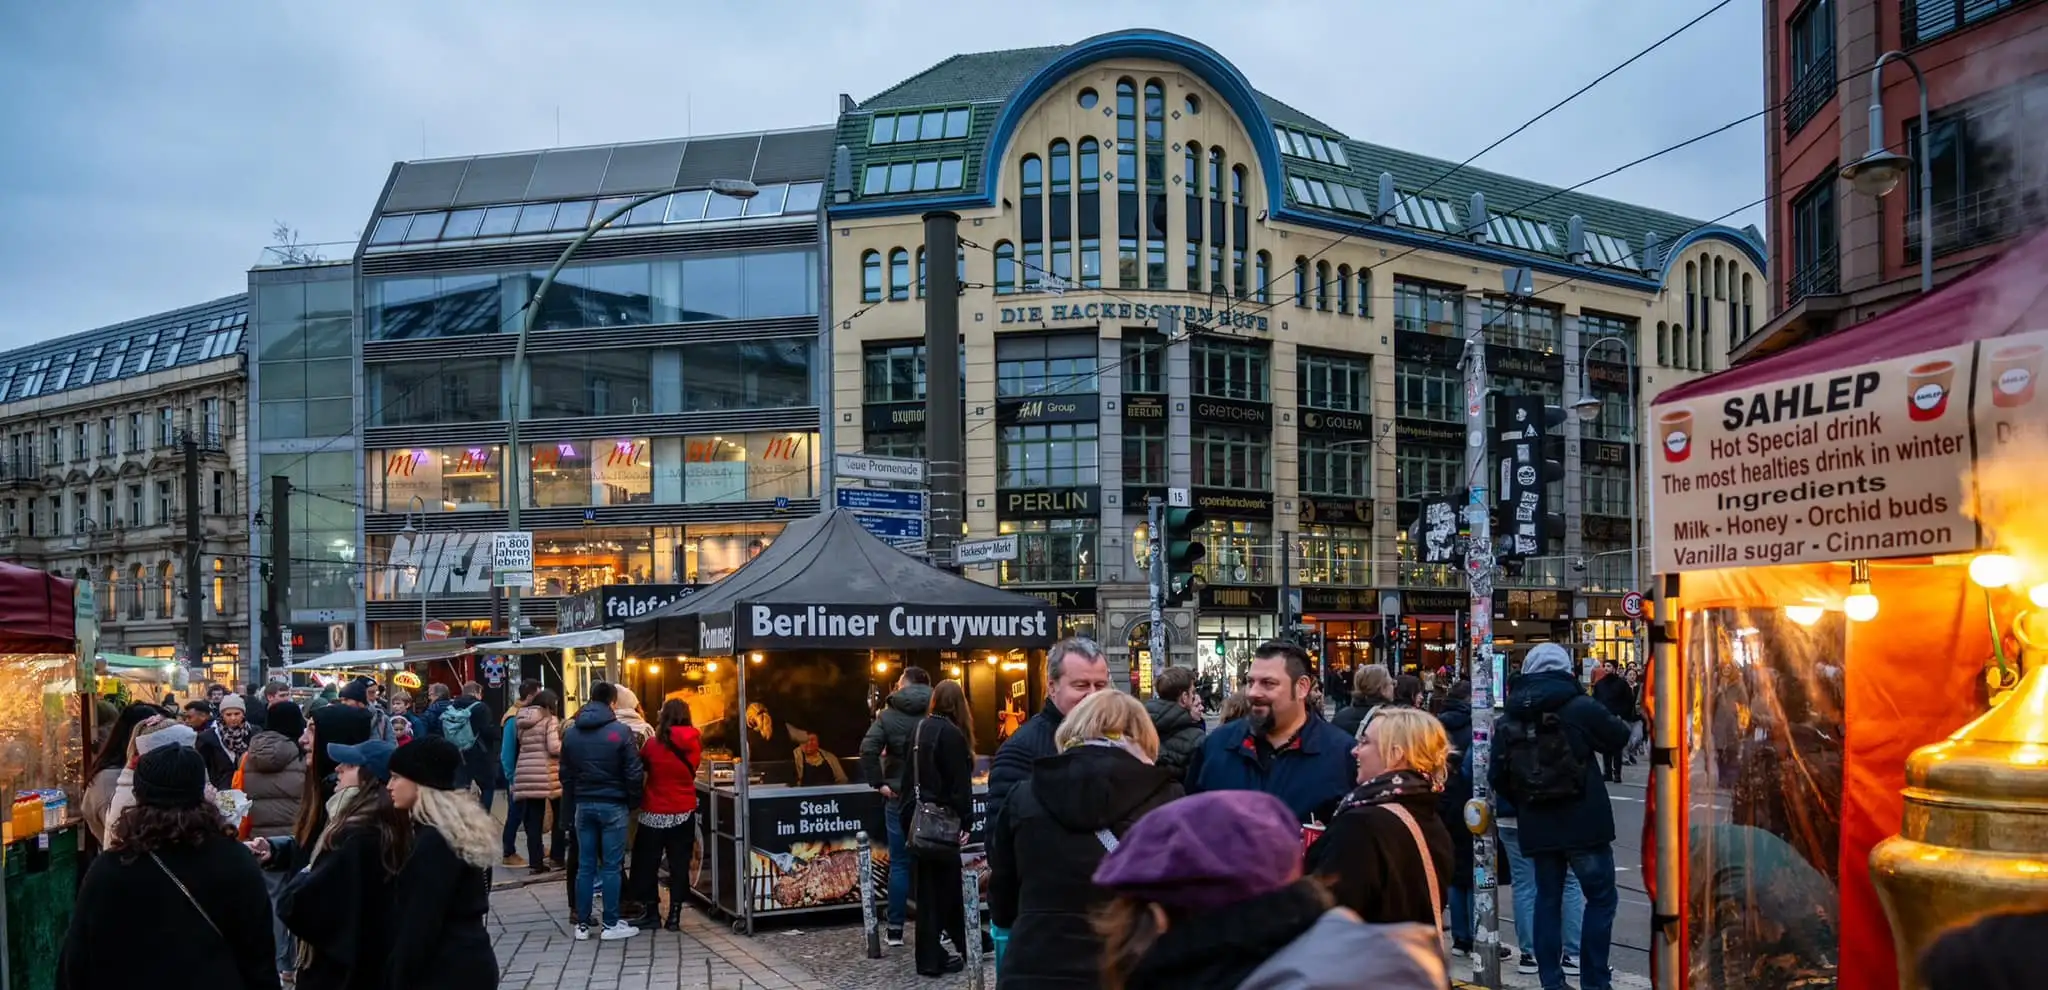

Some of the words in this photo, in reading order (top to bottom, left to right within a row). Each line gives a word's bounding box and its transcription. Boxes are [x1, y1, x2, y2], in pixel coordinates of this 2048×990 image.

[1000, 306, 1043, 324] DIE
[1047, 401, 1076, 414] Group
[1722, 371, 1880, 431] SAHLEP
[892, 407, 926, 425] oxymor
[1127, 407, 1163, 418] BERLIN
[1326, 416, 1363, 432] GOLEM
[1710, 437, 1741, 460] Hot
[1747, 421, 1818, 458] Special
[1826, 411, 1881, 441] drink
[868, 460, 918, 475] Promenade
[1661, 473, 1691, 494] The
[1695, 466, 1736, 490] most
[1742, 455, 1810, 484] healties
[1817, 447, 1865, 472] drink
[1872, 442, 1890, 464] in
[1896, 434, 1964, 460] winter
[1009, 491, 1088, 511] PERLIN
[1172, 491, 1184, 503] 15
[1717, 474, 1887, 512] Ingredients
[1674, 517, 1710, 541] Milk
[1727, 512, 1788, 539] Honey
[1808, 499, 1880, 527] Orchid
[1889, 493, 1948, 518] buds
[495, 547, 530, 557] Jahren
[496, 538, 506, 548] in
[509, 538, 529, 548] 800
[993, 542, 1011, 554] Markt
[1673, 543, 1737, 566] Vanilla
[1744, 539, 1805, 563] sugar
[1826, 525, 1952, 553] Cinnamon
[494, 555, 530, 566] leben?
[606, 595, 676, 617] falaf
[1214, 590, 1249, 605] PUMA
[1627, 598, 1641, 611] 30
[751, 605, 880, 637] Berliner
[889, 606, 1047, 645] Currywurst
[700, 621, 733, 650] Pommes
[800, 799, 839, 815] Steak
[777, 820, 795, 835] im
[800, 815, 862, 834] Brötchen
